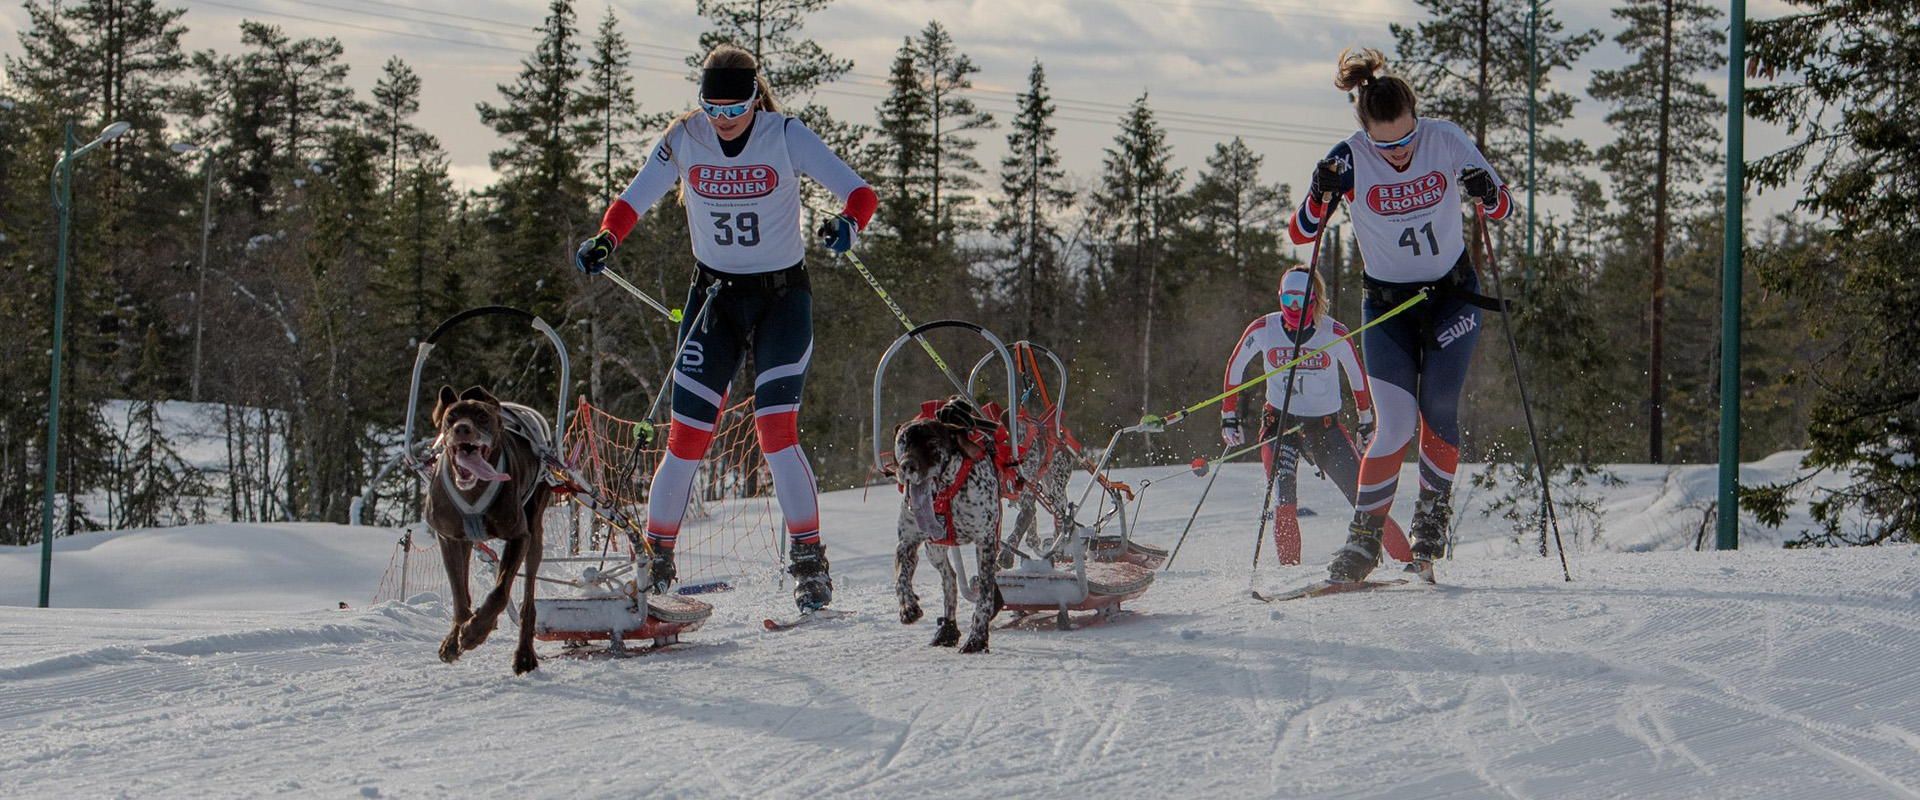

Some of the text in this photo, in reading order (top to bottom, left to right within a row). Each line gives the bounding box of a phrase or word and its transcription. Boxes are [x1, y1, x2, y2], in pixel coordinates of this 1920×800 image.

[699, 167, 767, 181] BENTO
[698, 181, 767, 194] KRONEN
[1379, 175, 1439, 198] BENTO
[1379, 187, 1443, 211] KRONEN
[710, 211, 761, 247] 39
[1398, 220, 1440, 257] 41
[1276, 349, 1323, 359] BENO
